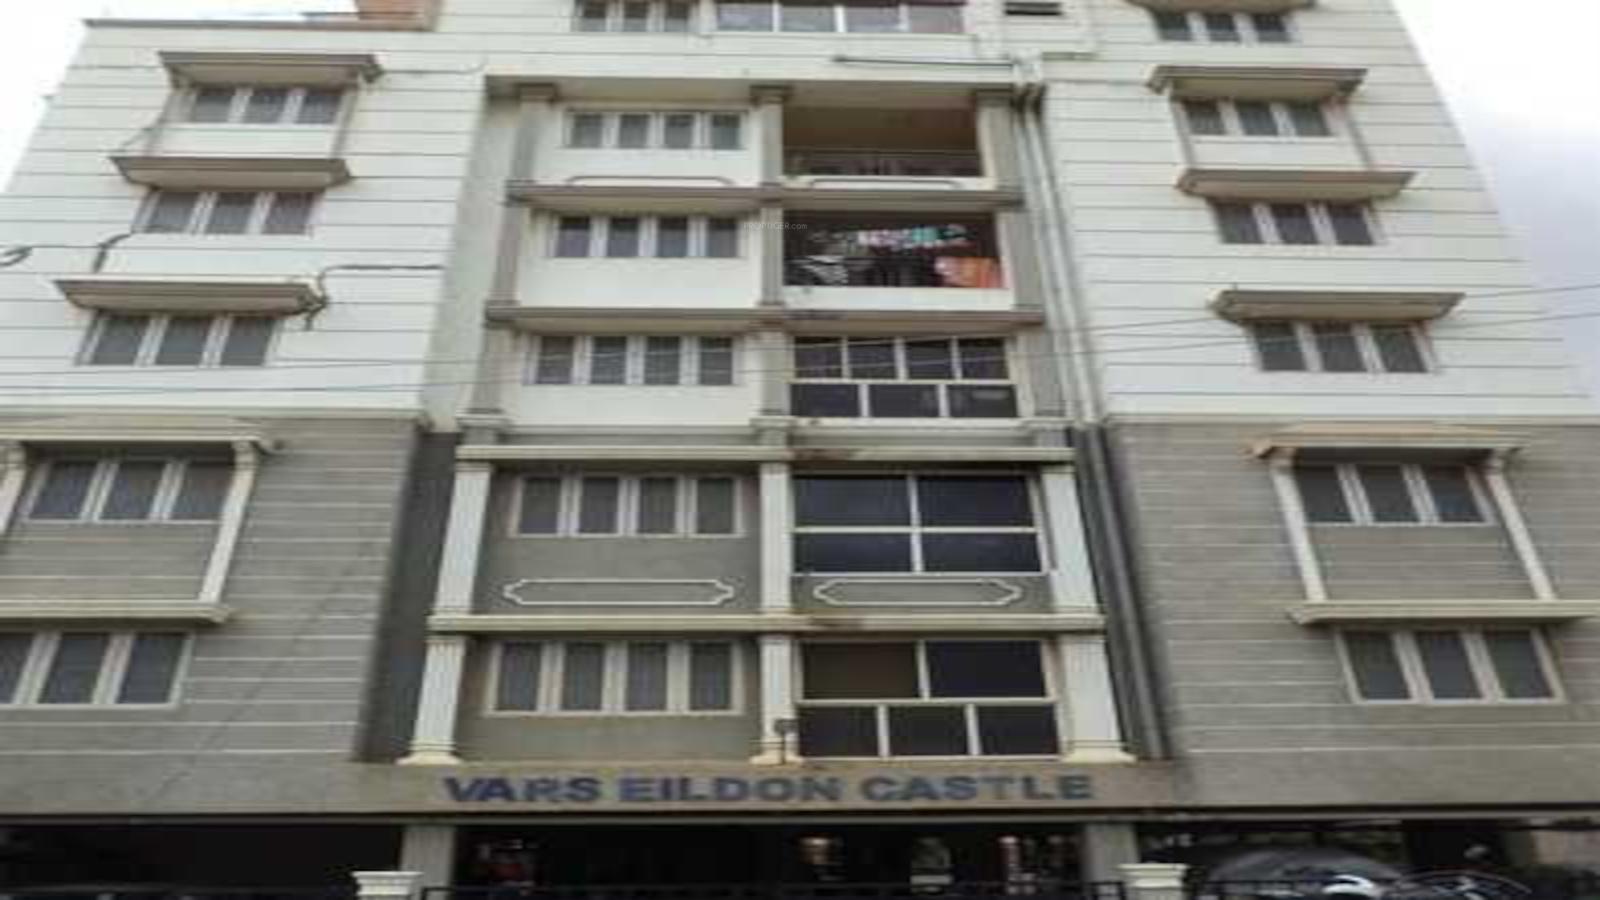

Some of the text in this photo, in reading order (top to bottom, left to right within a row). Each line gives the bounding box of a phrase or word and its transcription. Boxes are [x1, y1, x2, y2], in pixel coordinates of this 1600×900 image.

[444, 775, 1093, 803] VARS EILDON CASTLE
